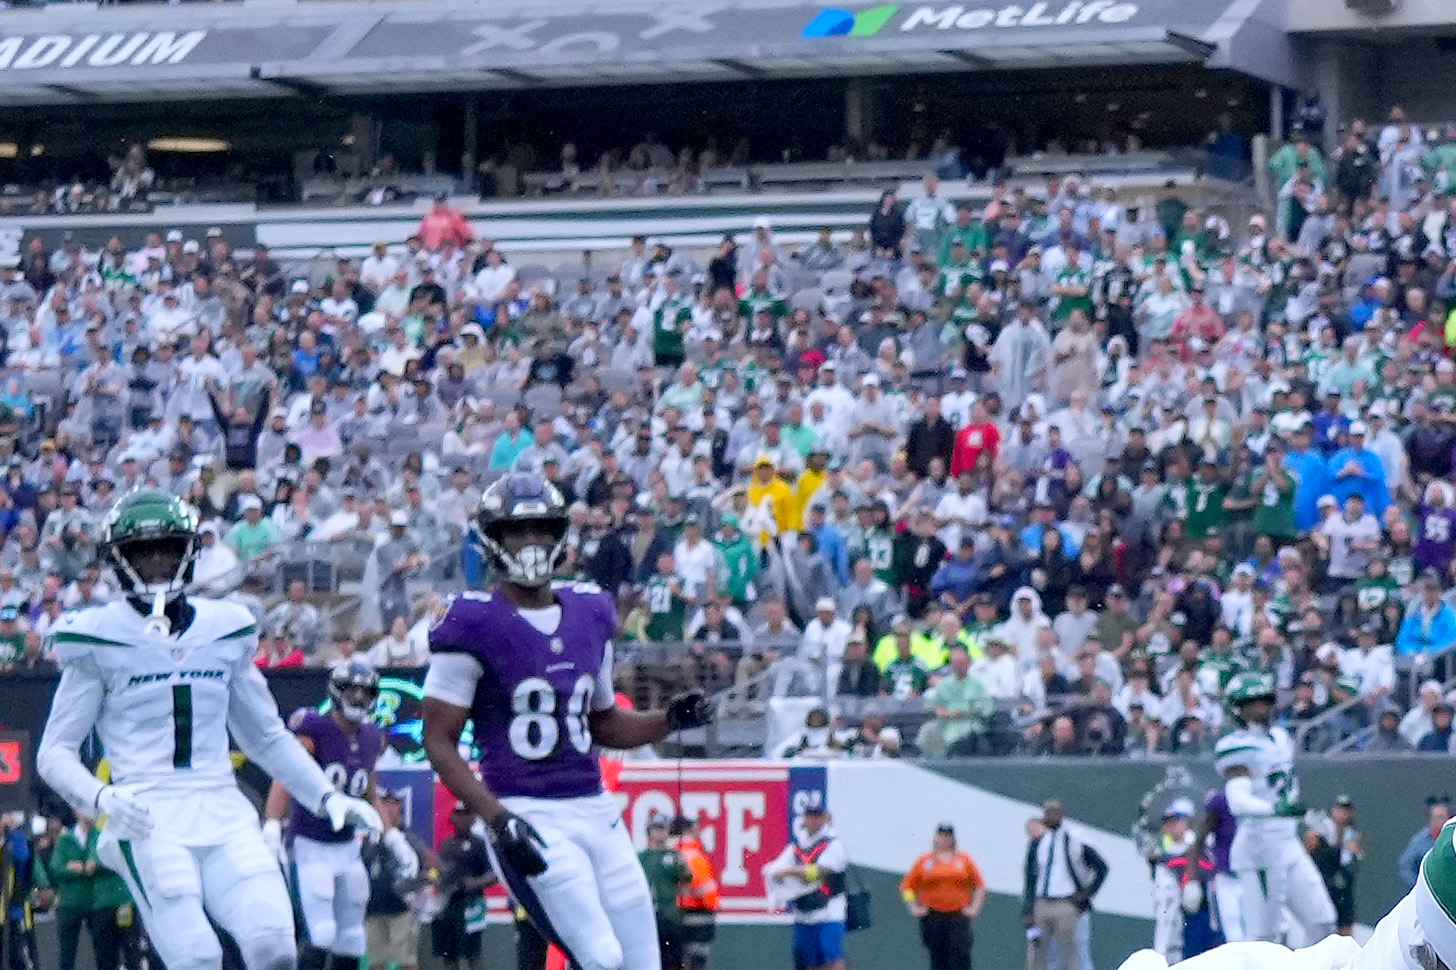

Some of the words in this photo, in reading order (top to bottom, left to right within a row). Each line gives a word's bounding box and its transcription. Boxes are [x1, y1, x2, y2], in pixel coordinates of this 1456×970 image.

[900, 0, 1137, 32] MetLife
[128, 671, 172, 686] NEW
[172, 684, 192, 768] 1
